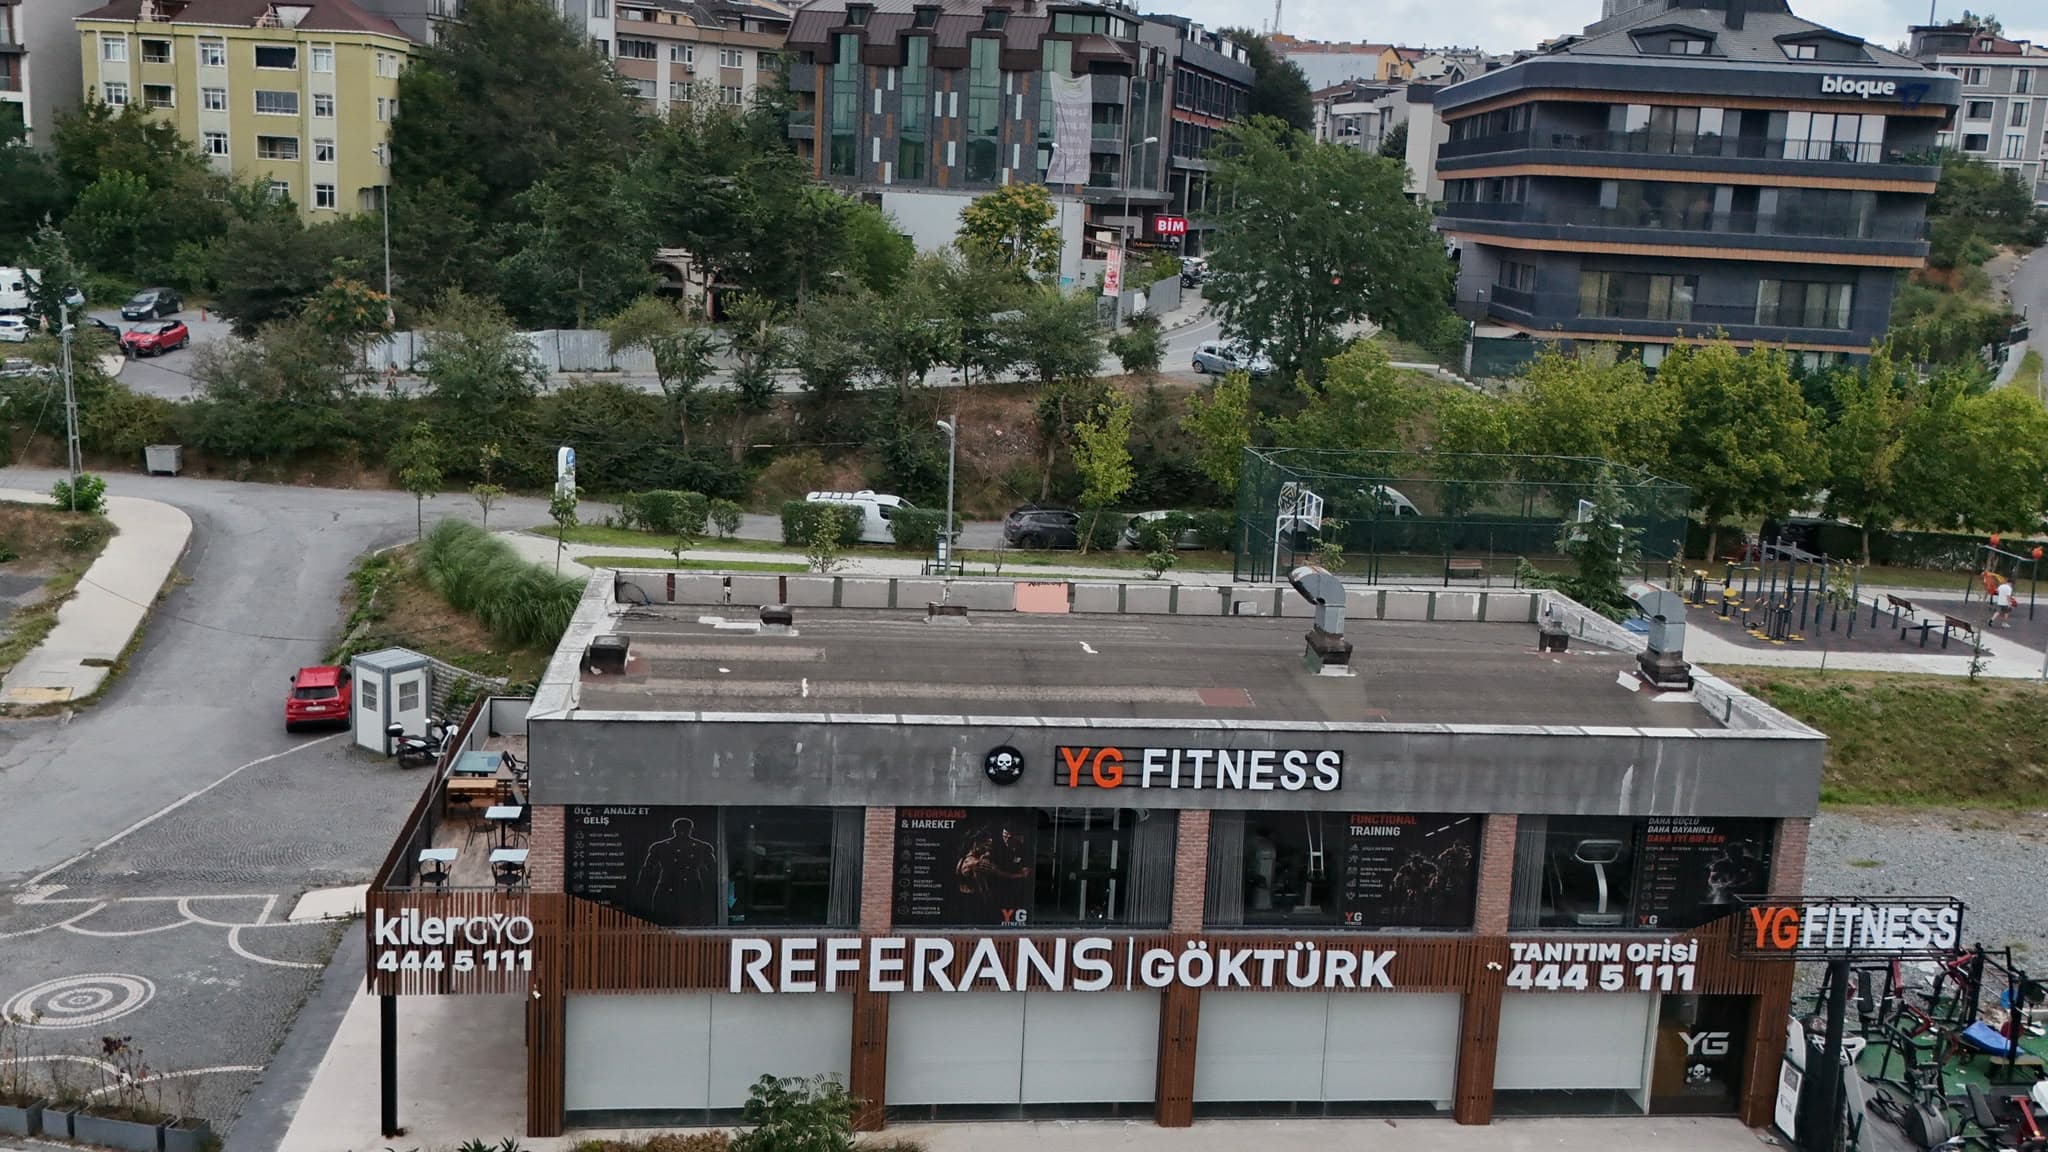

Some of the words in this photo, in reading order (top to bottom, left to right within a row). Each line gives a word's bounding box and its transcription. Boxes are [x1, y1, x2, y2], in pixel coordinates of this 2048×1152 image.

[1821, 75, 1896, 99] bloque
[1899, 82, 1930, 111] 17
[1158, 218, 1184, 232] BİM
[1060, 747, 1123, 788] YG
[1141, 748, 1341, 791] FITNESS
[639, 807, 650, 815] ET
[902, 809, 967, 819] PERFORMANS
[583, 816, 610, 826] GELİŞ
[901, 819, 909, 829] &
[911, 819, 956, 829] HAREKET
[1351, 815, 1417, 825] FUNCTIONAL
[1648, 817, 1671, 825] DAHA
[1350, 826, 1401, 836] TRAINING
[1671, 826, 1715, 834] DAYANIKLI
[1647, 834, 1672, 843] DAHA
[1001, 909, 1027, 922] YG
[1344, 911, 1363, 922] YG
[1640, 914, 1658, 925] YG
[1751, 907, 1799, 949] YG
[1801, 907, 1959, 949] FITNESS
[1510, 943, 1621, 962] TANITIM
[1626, 938, 1698, 962] OFİSİ
[377, 950, 445, 972] 444
[454, 950, 475, 972] 5
[483, 950, 533, 972] 111
[729, 937, 1114, 993] REFERANS
[1140, 940, 1397, 988] GÖKTÜRK
[1507, 963, 1588, 991] 444
[1599, 964, 1624, 991] 5
[1635, 963, 1696, 991] 111
[1678, 1031, 1730, 1055] YG
